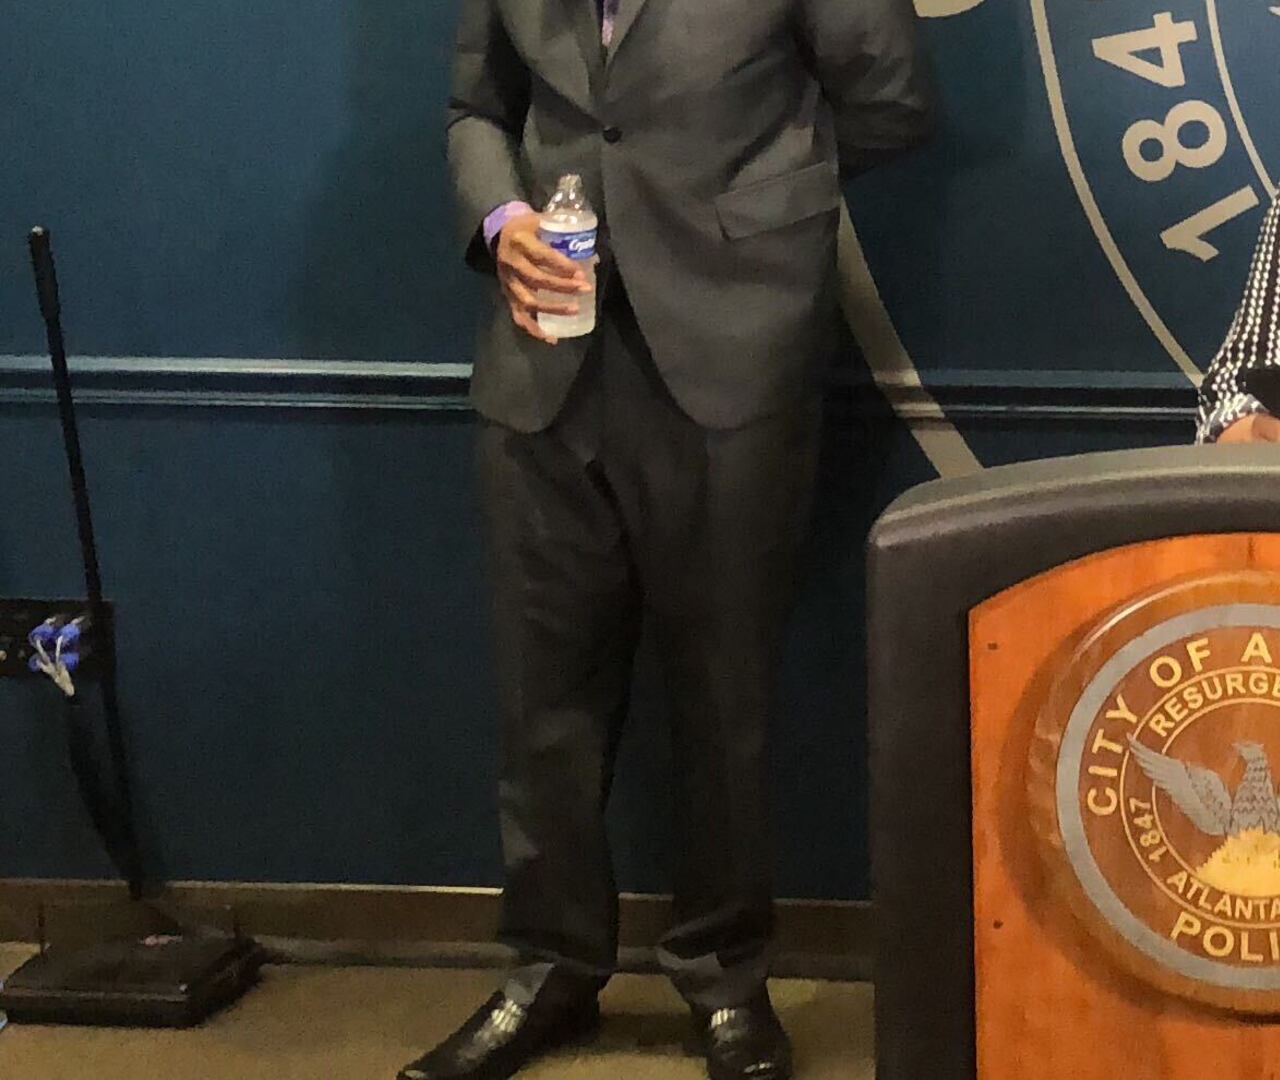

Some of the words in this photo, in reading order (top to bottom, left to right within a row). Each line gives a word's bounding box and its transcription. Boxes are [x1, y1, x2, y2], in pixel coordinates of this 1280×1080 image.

[1087, 694, 1139, 816] CITY
[1149, 639, 1211, 688] OF
[1130, 797, 1168, 863] 1847
